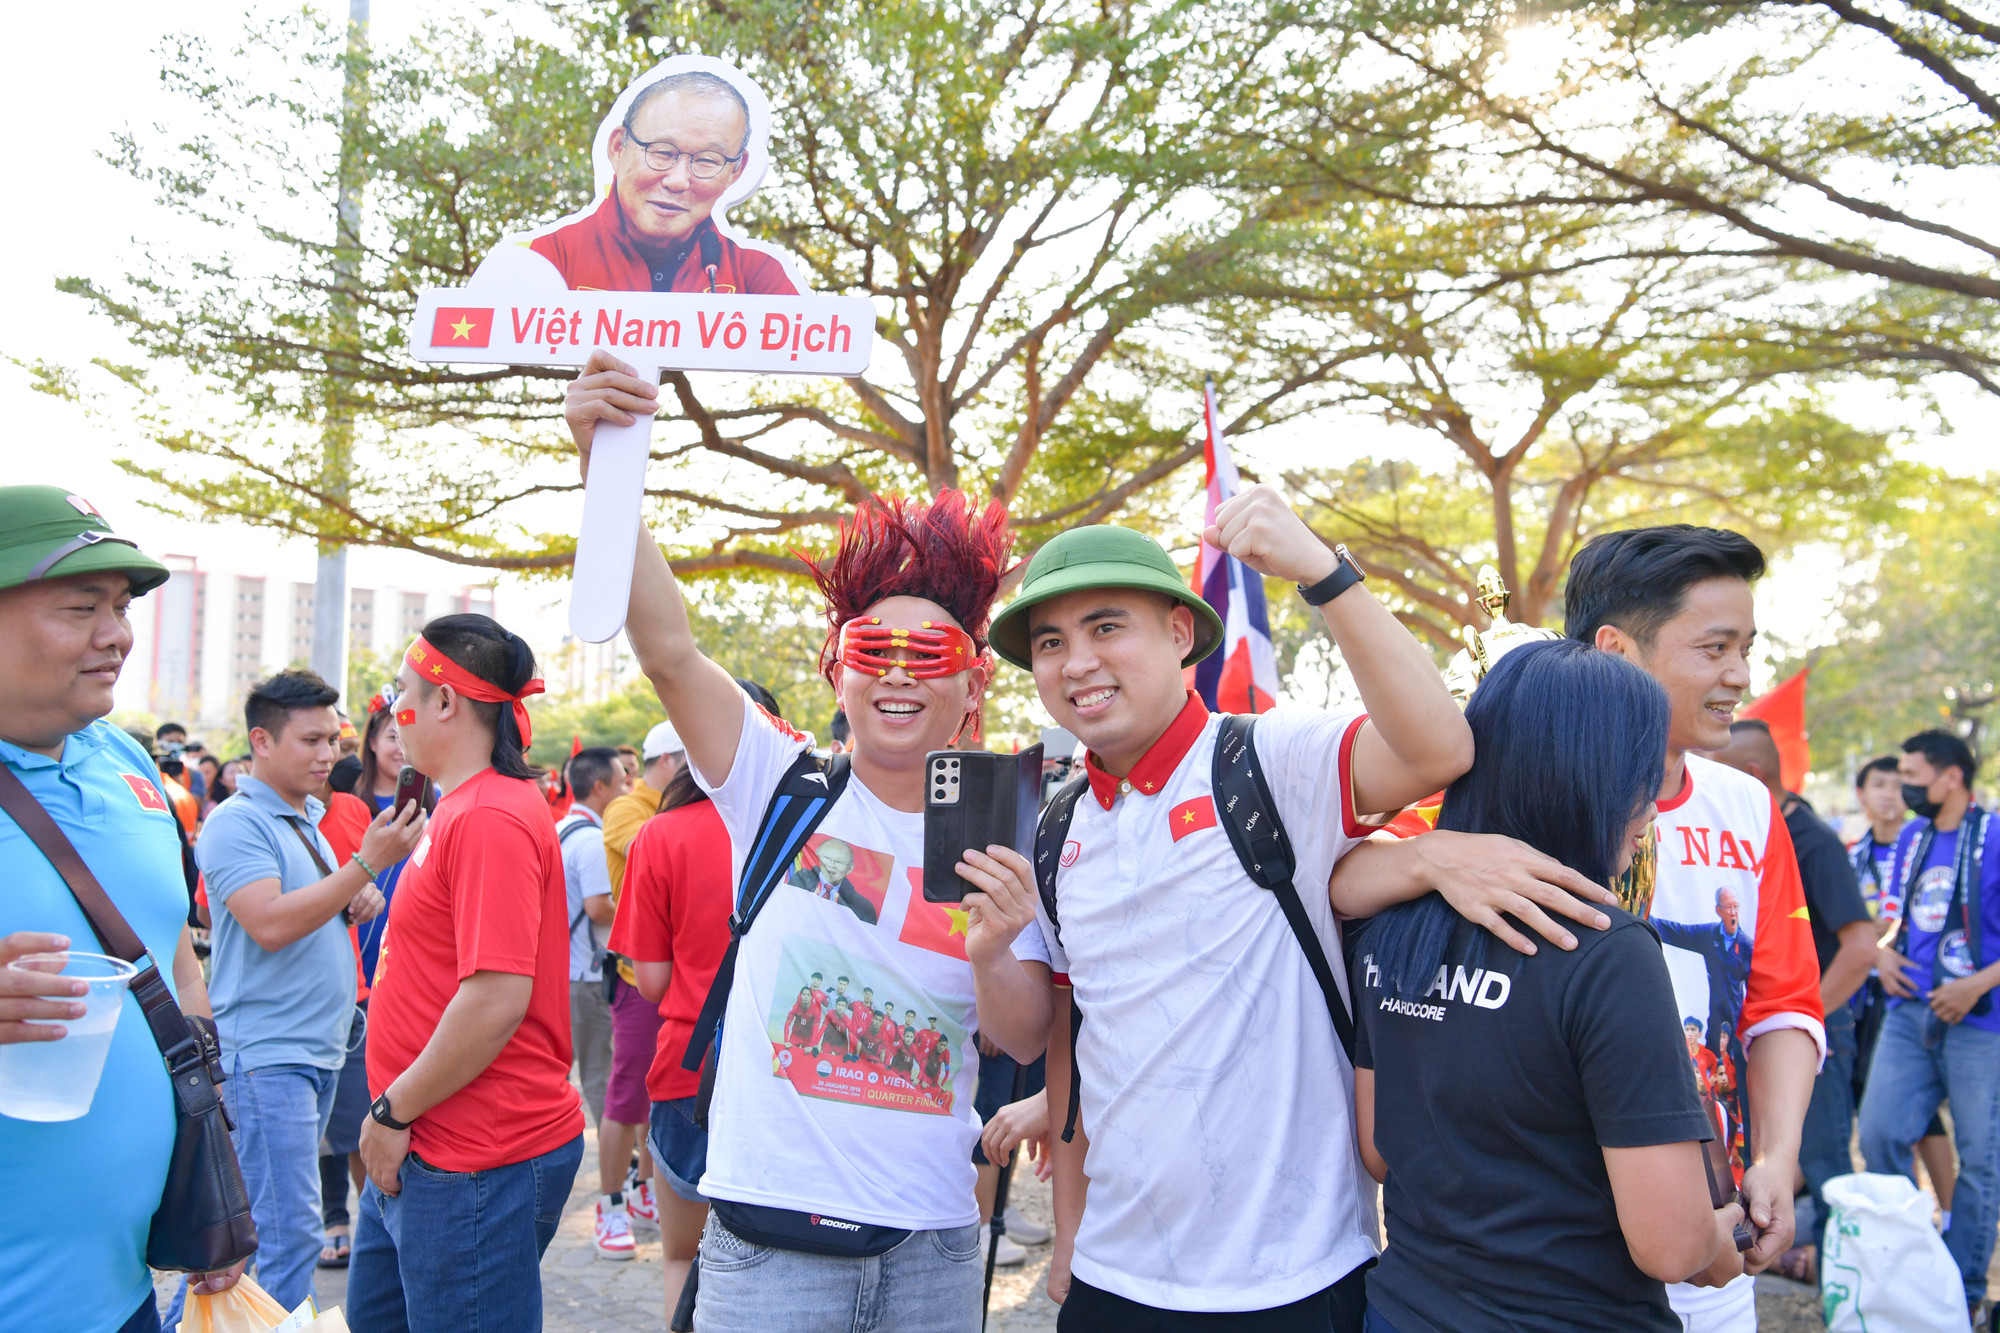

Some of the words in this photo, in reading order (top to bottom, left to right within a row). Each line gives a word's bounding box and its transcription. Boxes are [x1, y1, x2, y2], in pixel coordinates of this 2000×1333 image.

[511, 307, 582, 354] Việt
[594, 308, 681, 348] Nam
[697, 311, 748, 351] Vô
[760, 312, 852, 361] Địch
[1379, 996, 1447, 1022] HARDCORE
[835, 1066, 864, 1081] IRAQ
[867, 1089, 914, 1105] QUARTER
[819, 1218, 862, 1232] GOODFIT
